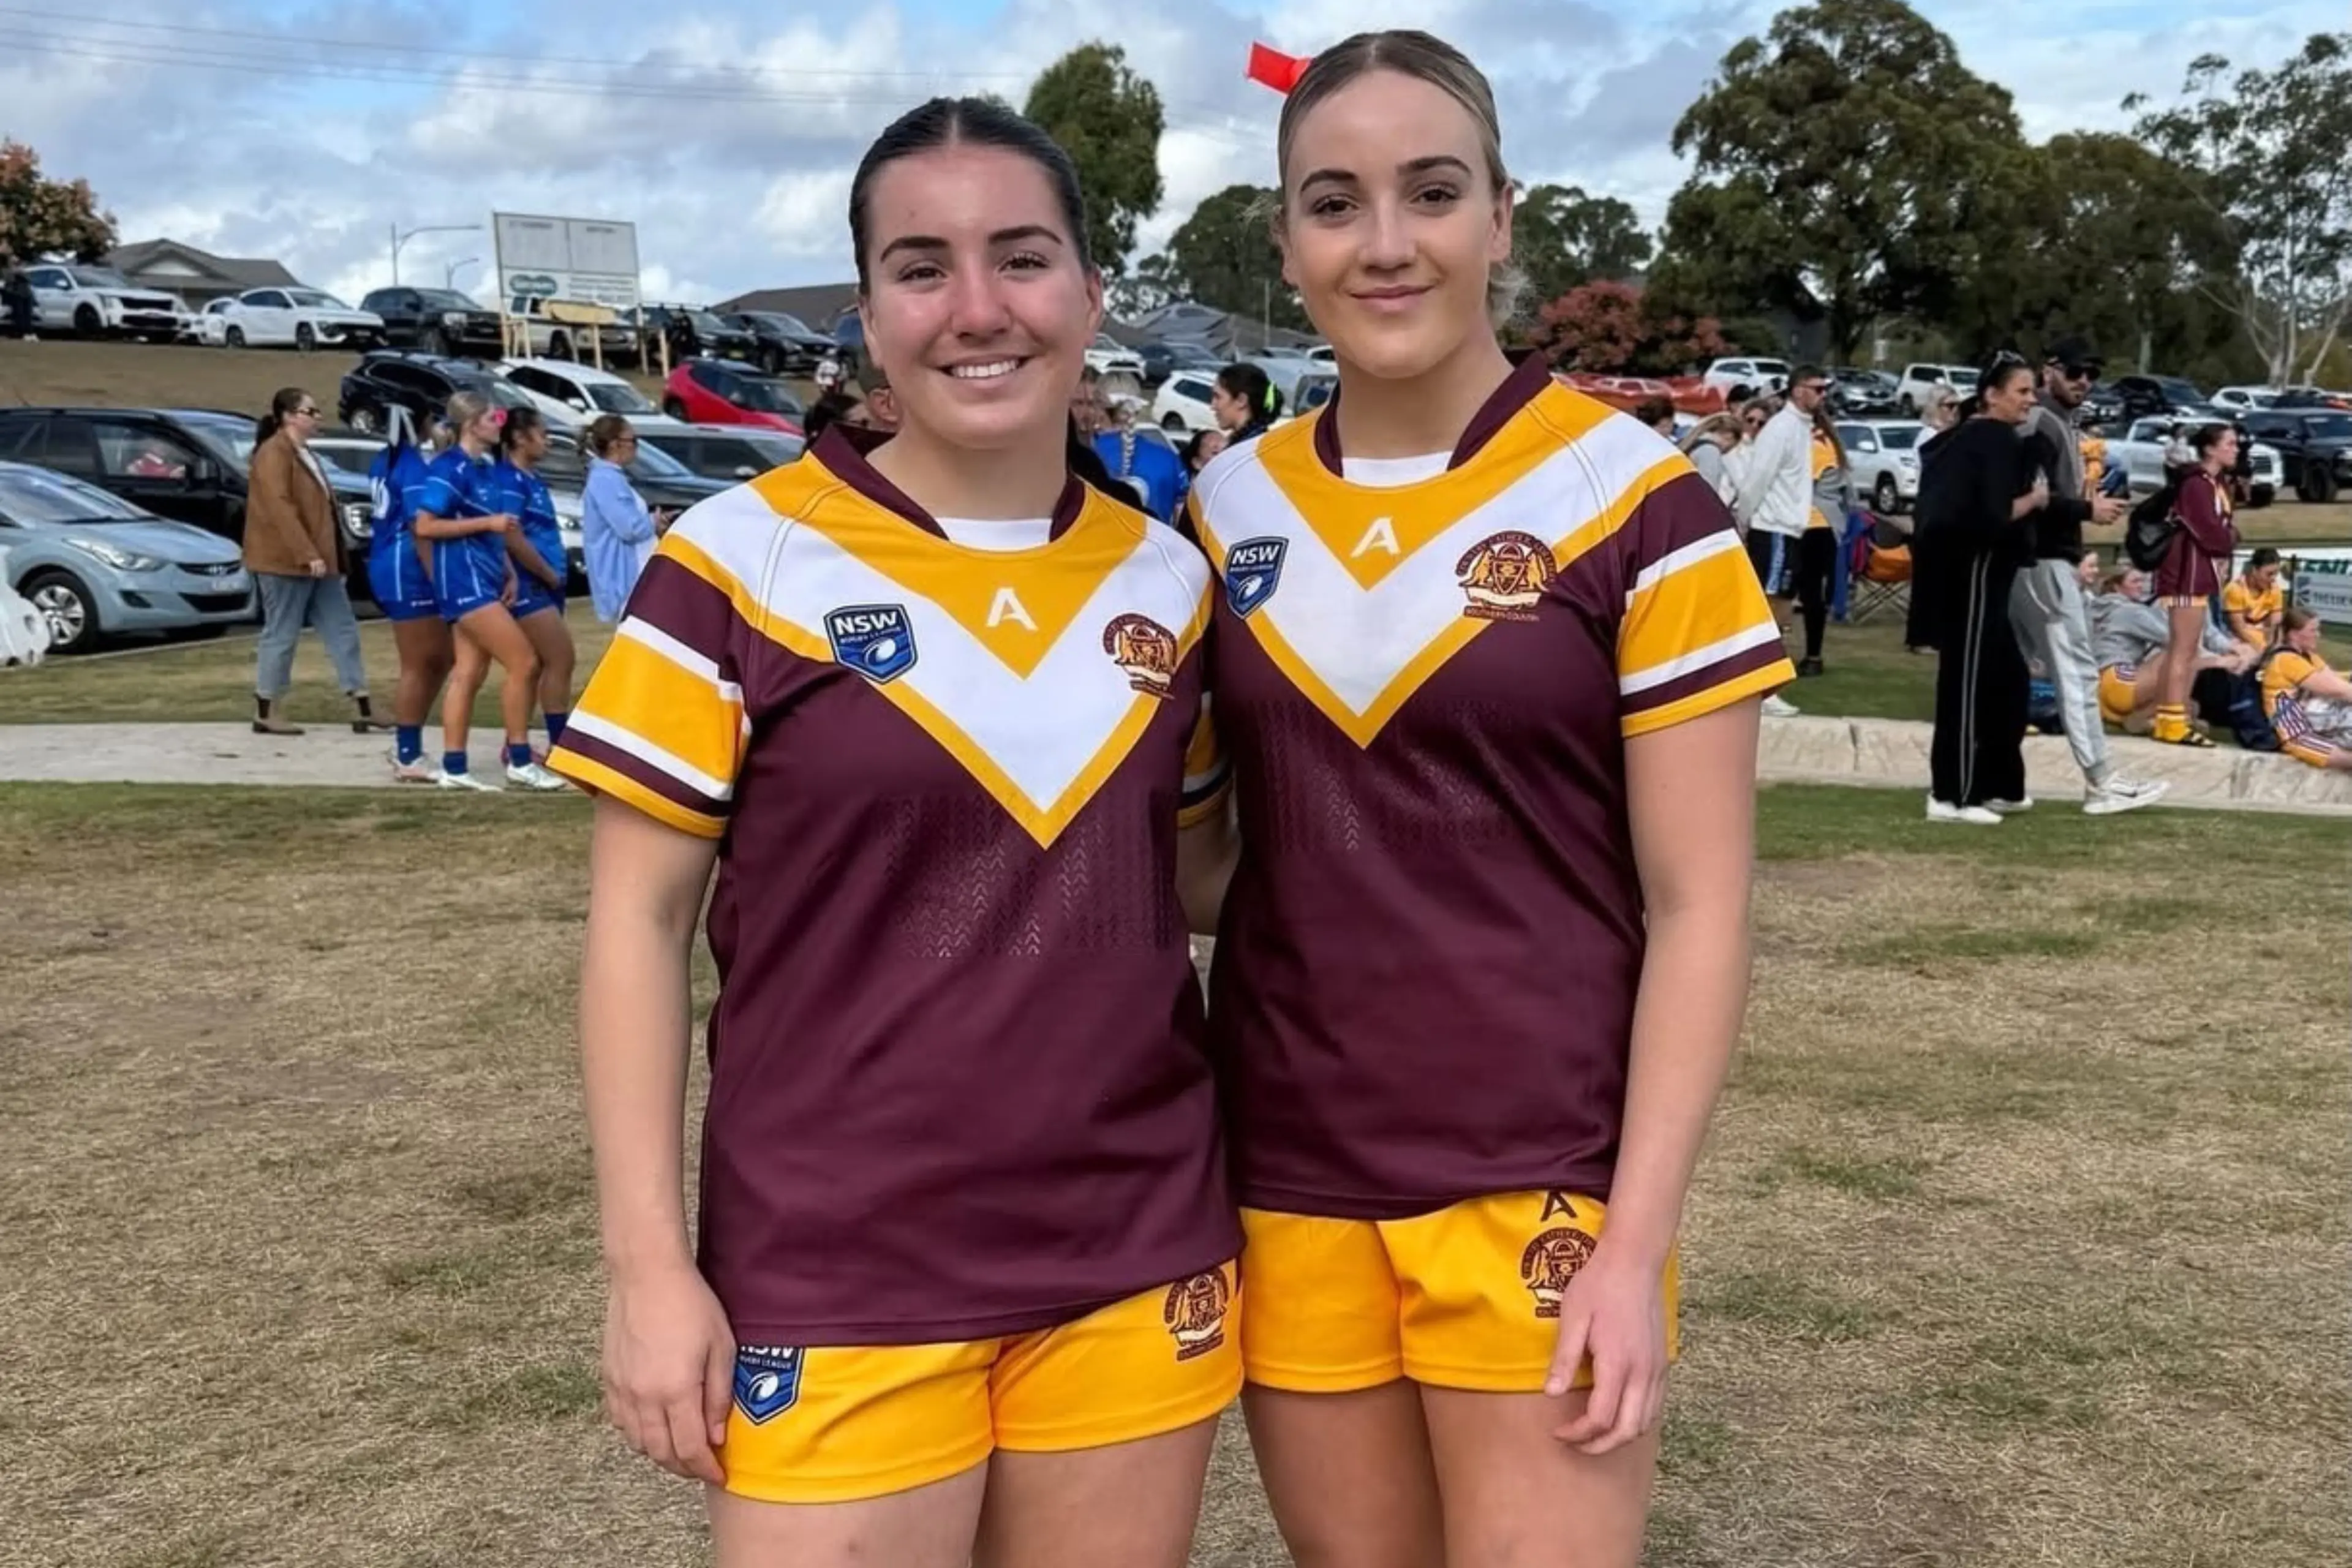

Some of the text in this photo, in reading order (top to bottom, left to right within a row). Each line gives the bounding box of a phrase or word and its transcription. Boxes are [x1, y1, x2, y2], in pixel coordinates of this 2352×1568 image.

[1351, 517, 1401, 556] A
[1232, 545, 1280, 564] NSW
[834, 611, 897, 635] NSW
[987, 587, 1038, 630] A
[1540, 1191, 1578, 1221] A
